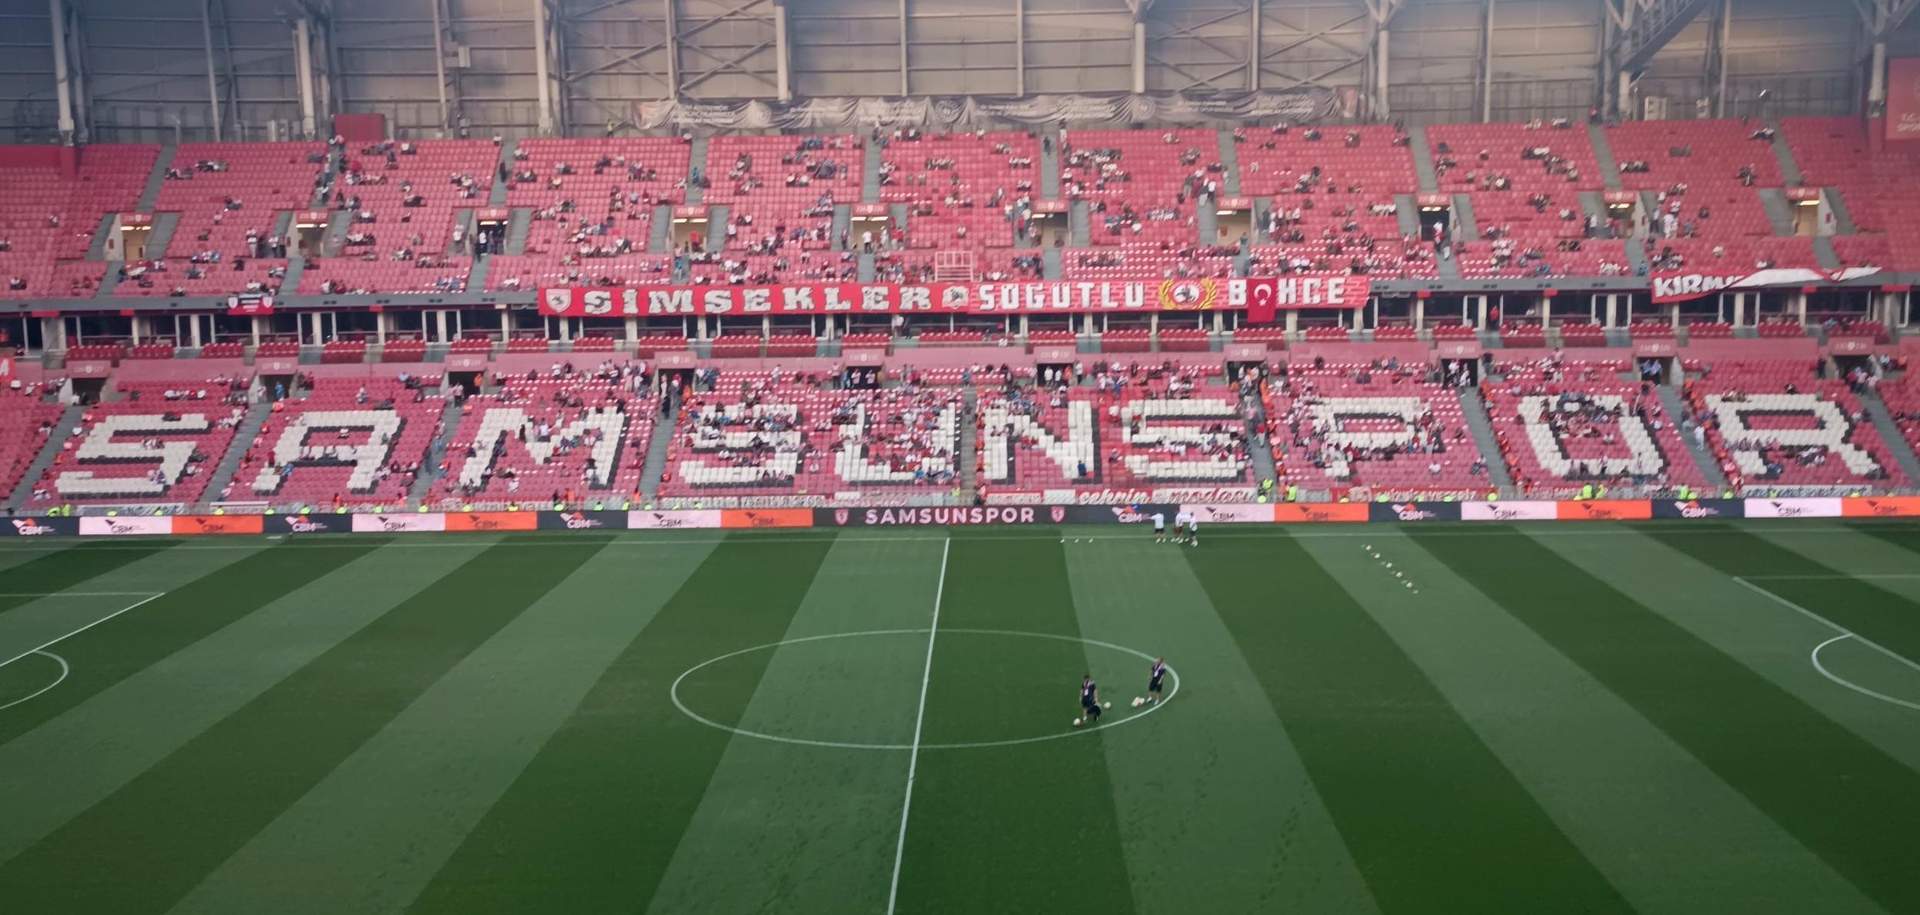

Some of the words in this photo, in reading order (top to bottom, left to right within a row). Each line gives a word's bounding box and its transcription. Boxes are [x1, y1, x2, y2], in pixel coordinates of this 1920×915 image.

[865, 507, 1034, 525] SAMSUNSPOR
[1399, 510, 1424, 520] CBM
[1681, 507, 1706, 518] CBM
[1118, 513, 1142, 523] CBM
[292, 522, 316, 532] CBM
[567, 519, 591, 529] CBM
[659, 519, 682, 528] CBM
[19, 526, 42, 535] CBM
